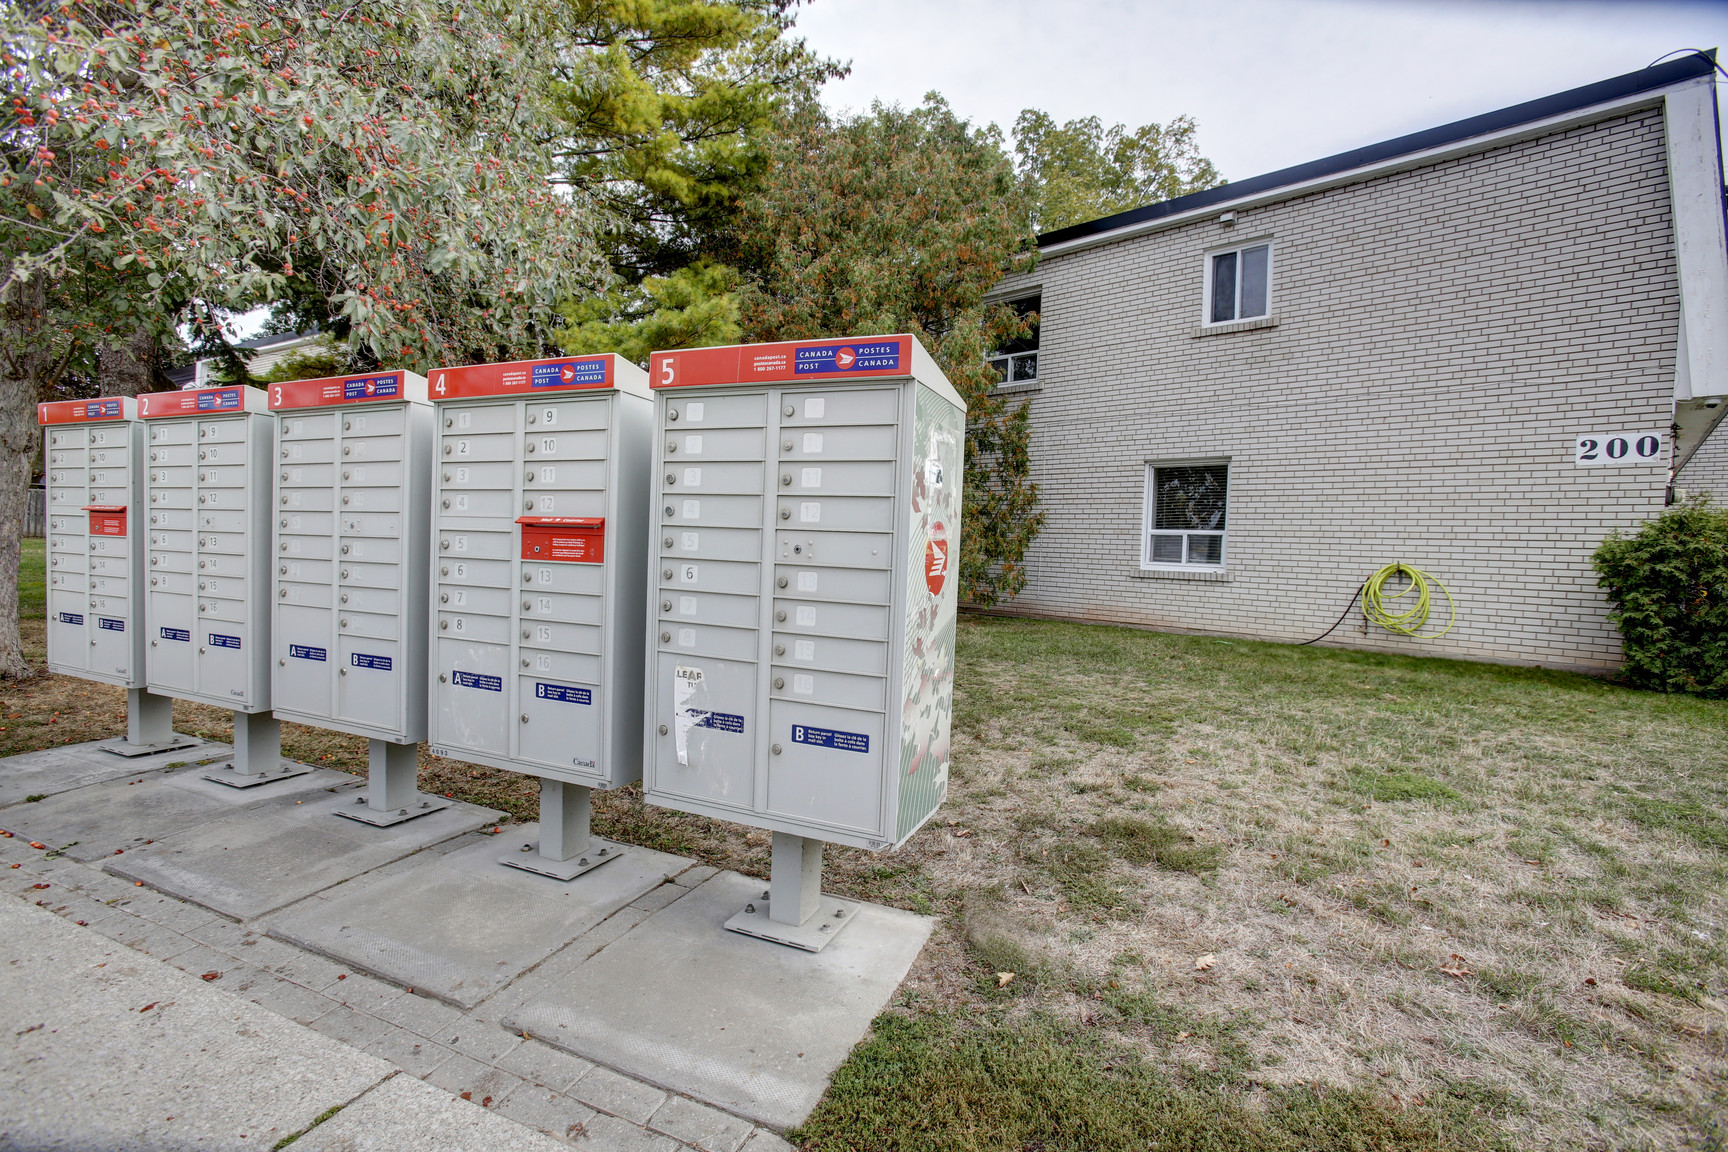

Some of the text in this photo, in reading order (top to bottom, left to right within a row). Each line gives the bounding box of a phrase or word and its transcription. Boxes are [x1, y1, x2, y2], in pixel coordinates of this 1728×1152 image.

[661, 358, 674, 384] 5
[435, 373, 447, 395] 4
[274, 386, 282, 406] 3
[142, 398, 149, 416] 2
[42, 406, 48, 422] 1
[462, 414, 467, 426] 1
[546, 410, 553, 422] 9
[162, 430, 165, 438] 1
[211, 427, 216, 437] 9
[460, 442, 467, 454] 2
[544, 439, 555, 452] 10
[1579, 435, 1659, 461] 200
[99, 453, 105, 461] 10
[161, 450, 166, 460] 2
[210, 448, 218, 458] 10
[161, 472, 166, 481] 3
[210, 471, 217, 480] 11
[459, 469, 466, 481] 3
[543, 468, 554, 481] 11
[689, 471, 697, 483] 3
[804, 470, 818, 483] 11
[161, 493, 166, 501] 4
[210, 493, 217, 503] 12
[458, 496, 465, 508] 4
[541, 497, 553, 510] 12
[687, 503, 696, 515] 4
[804, 505, 820, 518] 12
[162, 513, 166, 523] 5
[210, 537, 217, 546] 13
[458, 536, 464, 548] 5
[686, 535, 694, 548] 5
[162, 556, 166, 565] 7
[210, 559, 217, 568] 14
[457, 565, 464, 576] 6
[539, 570, 551, 583] 13
[686, 567, 694, 580] 6
[210, 581, 217, 590] 15
[457, 592, 463, 603] 7
[539, 599, 550, 611] 14
[60, 614, 64, 622] A
[100, 620, 104, 628] B
[456, 619, 462, 630] 8
[162, 629, 166, 637] A
[538, 627, 550, 640] 15
[684, 631, 692, 643] 8
[210, 635, 214, 644] B
[291, 646, 296, 656] A
[353, 655, 358, 665] B
[537, 656, 549, 668] 16
[454, 672, 462, 684] A
[538, 684, 545, 697] B
[796, 727, 804, 741] B
[573, 758, 595, 768] Canada
